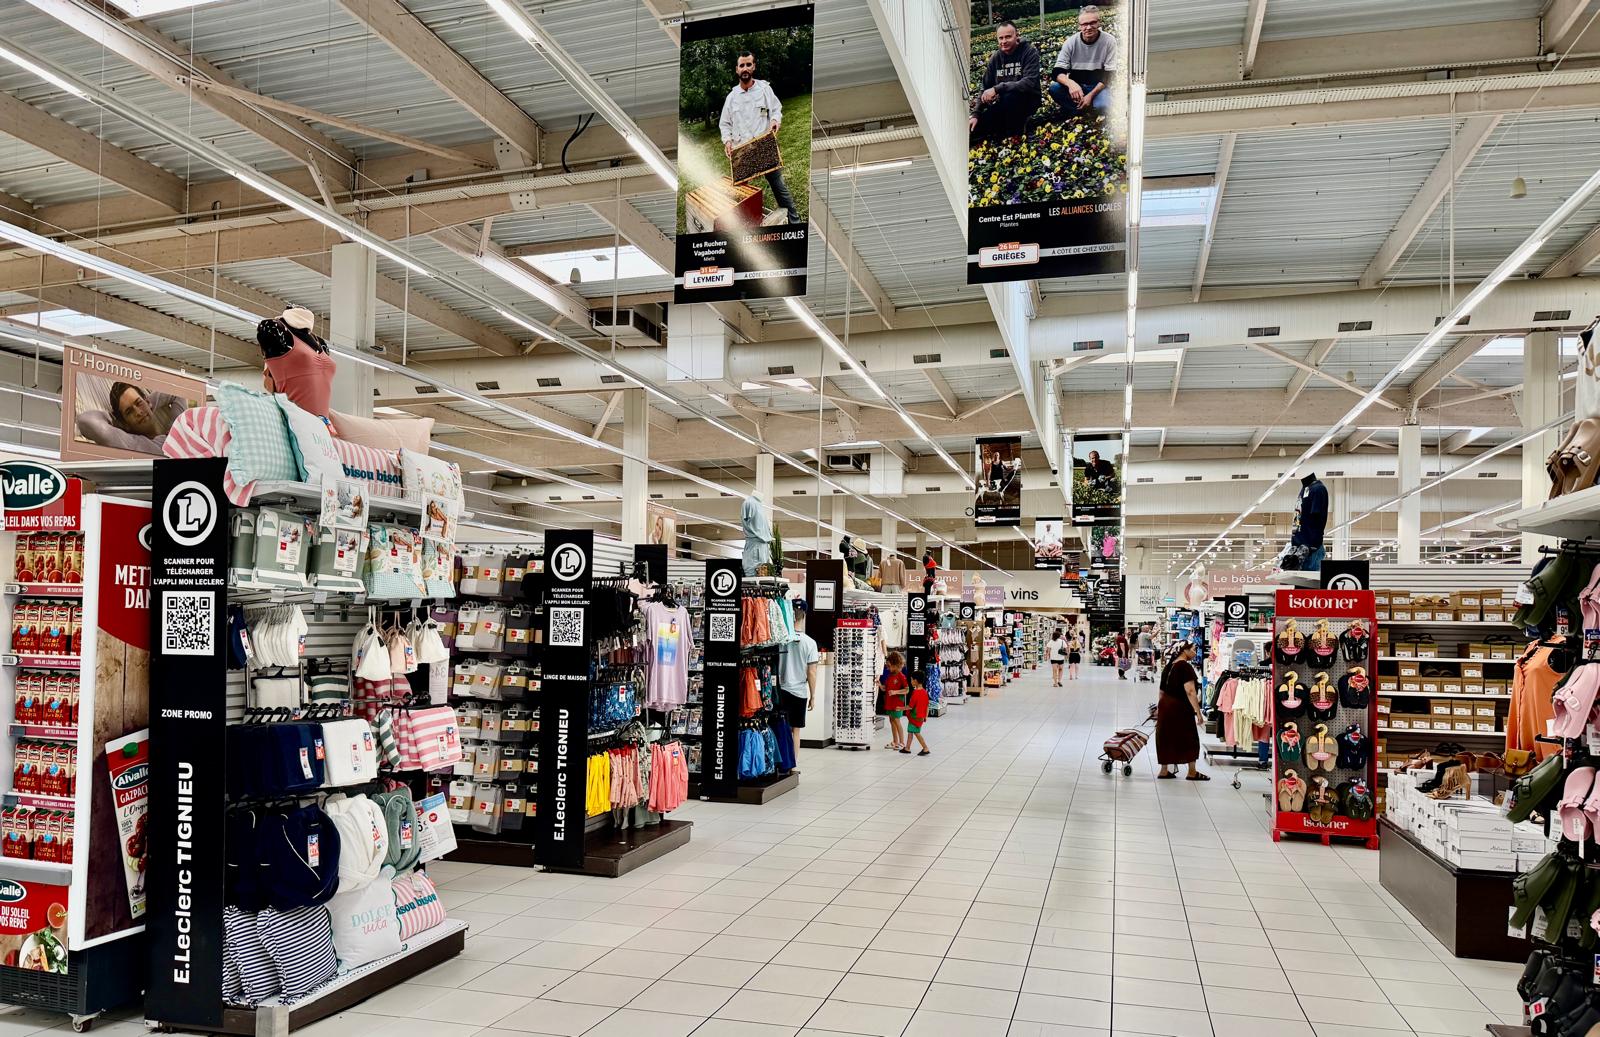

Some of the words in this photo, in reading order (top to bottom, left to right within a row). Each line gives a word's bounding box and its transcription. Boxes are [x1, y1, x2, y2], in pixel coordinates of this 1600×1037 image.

[1049, 207, 1060, 216] LES
[1061, 204, 1094, 216] ALLIANCES
[1095, 202, 1122, 213] LOCALES
[978, 215, 1001, 224] Centre
[1002, 214, 1014, 222] Est
[1015, 212, 1041, 221] Plantes
[742, 235, 753, 243] LES
[753, 232, 781, 243] ALLIANCES
[781, 229, 805, 241] LOCALES
[692, 241, 703, 249] Les
[704, 239, 727, 248] Ruchers
[1008, 242, 1019, 250] km
[693, 247, 725, 257] Vagabonds
[991, 251, 1026, 261] GRIÈGES
[692, 274, 725, 284] LEYMENT
[69, 349, 143, 381] L'Homme
[341, 463, 375, 481] bisou
[5, 515, 20, 528] LEIL
[21, 515, 40, 528] DANS
[40, 515, 54, 528] VOS
[54, 515, 76, 528] REPAS
[163, 557, 195, 566] SCANNER
[195, 557, 215, 566] POUR
[166, 566, 214, 576] TÉLÉCHARGER
[153, 578, 177, 586] L'APPLI
[178, 578, 194, 586] MON
[194, 578, 225, 586] LECLERC
[909, 574, 921, 582] La
[1213, 574, 1228, 583] Le
[1231, 574, 1262, 584] bébé
[1010, 587, 1039, 601] vins
[1288, 593, 1358, 609] isotoner
[567, 674, 588, 682] MAISON
[161, 708, 183, 719] ZONE
[184, 709, 213, 720] PROMO
[716, 685, 726, 730] TIGNIEU
[556, 708, 570, 769] TIGNIEU
[715, 730, 725, 780] E.Leclerc
[176, 762, 194, 865] TIGNIEU
[553, 773, 567, 841] E.Leclerc
[414, 892, 437, 907] bisou
[1, 905, 10, 916] DU
[10, 906, 31, 919] SOLEIL
[9, 917, 28, 930] REPAS
[173, 869, 193, 984] E.Leclerc
